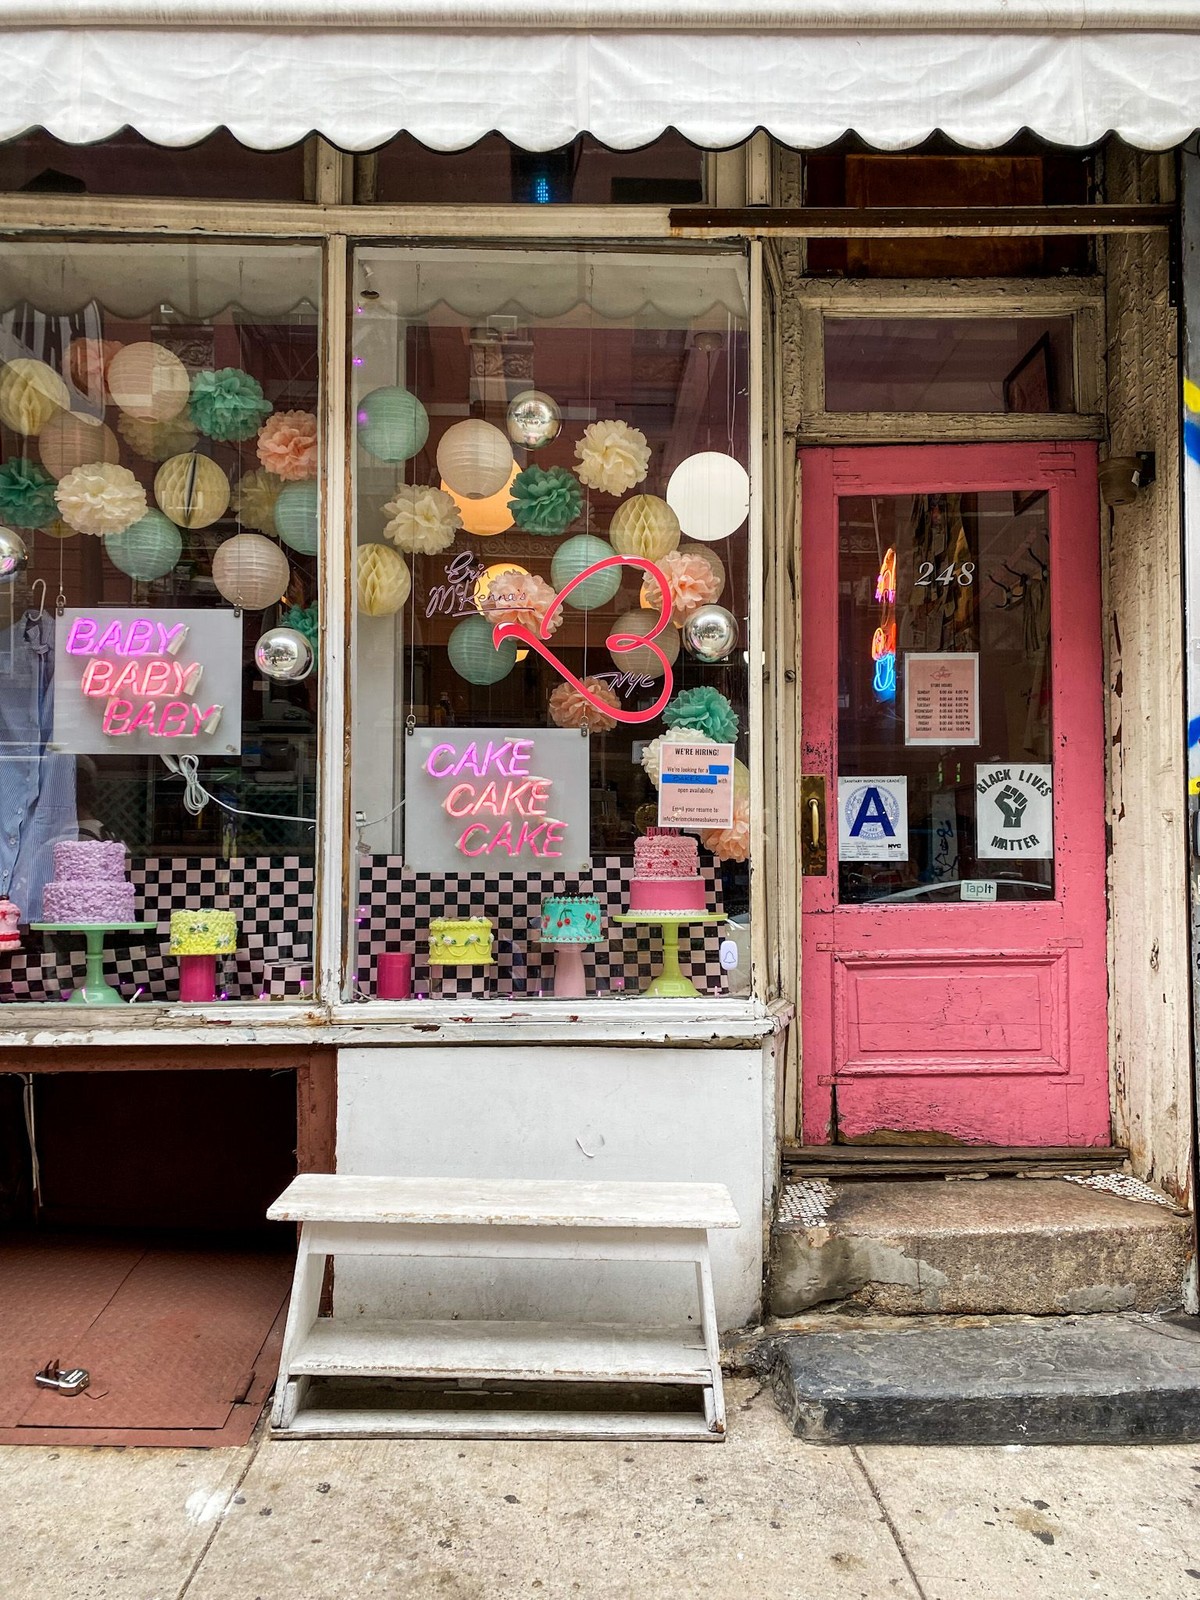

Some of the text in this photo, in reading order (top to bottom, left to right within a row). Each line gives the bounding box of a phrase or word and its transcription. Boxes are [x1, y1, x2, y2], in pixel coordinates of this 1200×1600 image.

[444, 550, 490, 584] Erin
[914, 561, 976, 586] 248
[426, 579, 527, 618] McKenna's
[66, 617, 186, 656] BABY
[82, 660, 201, 697] BABY
[593, 671, 655, 698] NYC
[103, 699, 219, 737] BABY
[427, 739, 535, 777] CAKE
[675, 748, 720, 756] WE'RE HIRING!
[446, 780, 553, 817] CAKE
[977, 769, 1052, 797] BLACK LIVES
[849, 787, 896, 837] A
[460, 821, 569, 857] CAKE
[990, 834, 1041, 851] MATTER
[964, 882, 994, 896] TapIt
